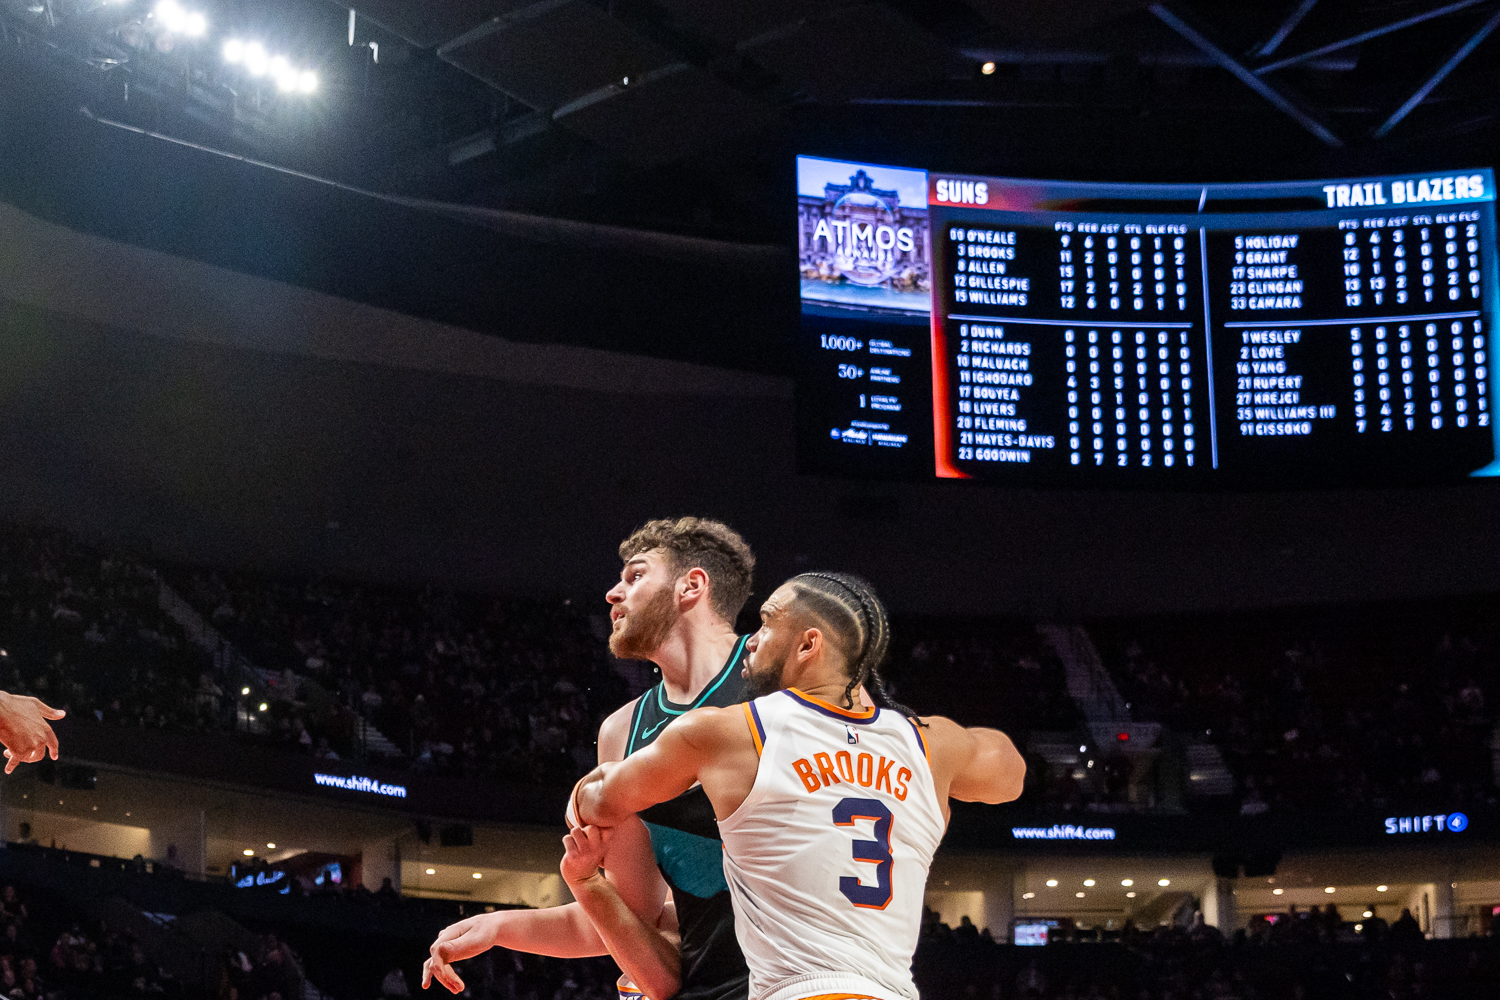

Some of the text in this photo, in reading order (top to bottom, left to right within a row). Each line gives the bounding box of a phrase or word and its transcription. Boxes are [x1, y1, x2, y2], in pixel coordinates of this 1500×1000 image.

[936, 179, 988, 205] SUNS
[1323, 174, 1484, 208] TRAIL BLAZERS
[813, 219, 915, 252] ATMOS
[950, 228, 1184, 250] 00 O'NEALE 9 6 0 0 1 0
[1235, 236, 1244, 249] 5
[1245, 235, 1298, 248] HOLIDAY
[1369, 230, 1381, 244] 4
[1393, 229, 1404, 243] 3
[1420, 228, 1429, 241] 1
[1445, 226, 1456, 239] 0
[1466, 223, 1477, 237] 2
[958, 244, 1185, 265] 3 BROOKS 11 2 0 0 0 2
[1235, 239, 1478, 264] 9 GRANT 12 1 4 0 0 0
[968, 260, 1006, 274] ALLEN
[1060, 265, 1074, 278] 15
[1086, 265, 1094, 279] 1
[1110, 266, 1117, 279] 1
[1132, 267, 1142, 280] 0
[1154, 267, 1164, 280] 0
[1176, 267, 1184, 280] 1
[1232, 254, 1478, 279] 17 SHARPE 10 1 0 0 0 1
[954, 274, 1186, 295] 12 GILLESPIE 17 2 7 2 0 0
[1230, 280, 1303, 295] 23 CLINGAN
[955, 289, 1186, 310] 15 WILLIAMS 12 6 0 0 1 1
[1231, 295, 1303, 310] 33 CAMARA
[960, 324, 969, 337] 0
[1242, 330, 1301, 344] 1 WESLEY
[961, 340, 1031, 356] 2 RICHARDS
[1240, 345, 1284, 359] 2 LOVE
[957, 354, 970, 367] 10
[1237, 361, 1286, 374] 16 YANG
[960, 370, 1033, 386] 11 IGHODARO
[1238, 375, 1302, 389] 21 RUPERT
[959, 385, 1020, 401] 17 BOUYEA
[1236, 392, 1252, 405] 27
[973, 402, 1016, 416] LIVERS
[1254, 405, 1318, 419] WILLIAMS
[1319, 405, 1336, 419] III
[957, 416, 1027, 431] 20 FLEMING
[1240, 422, 1254, 436] 91
[960, 431, 1055, 449] 21 HAYES-DAVIS
[958, 446, 1030, 463] 23 GOODWIN
[791, 750, 912, 801] BROOKS
[314, 773, 407, 798] www.shift4.com
[1012, 824, 1115, 840] www.shift4.com
[832, 797, 894, 910] 3
